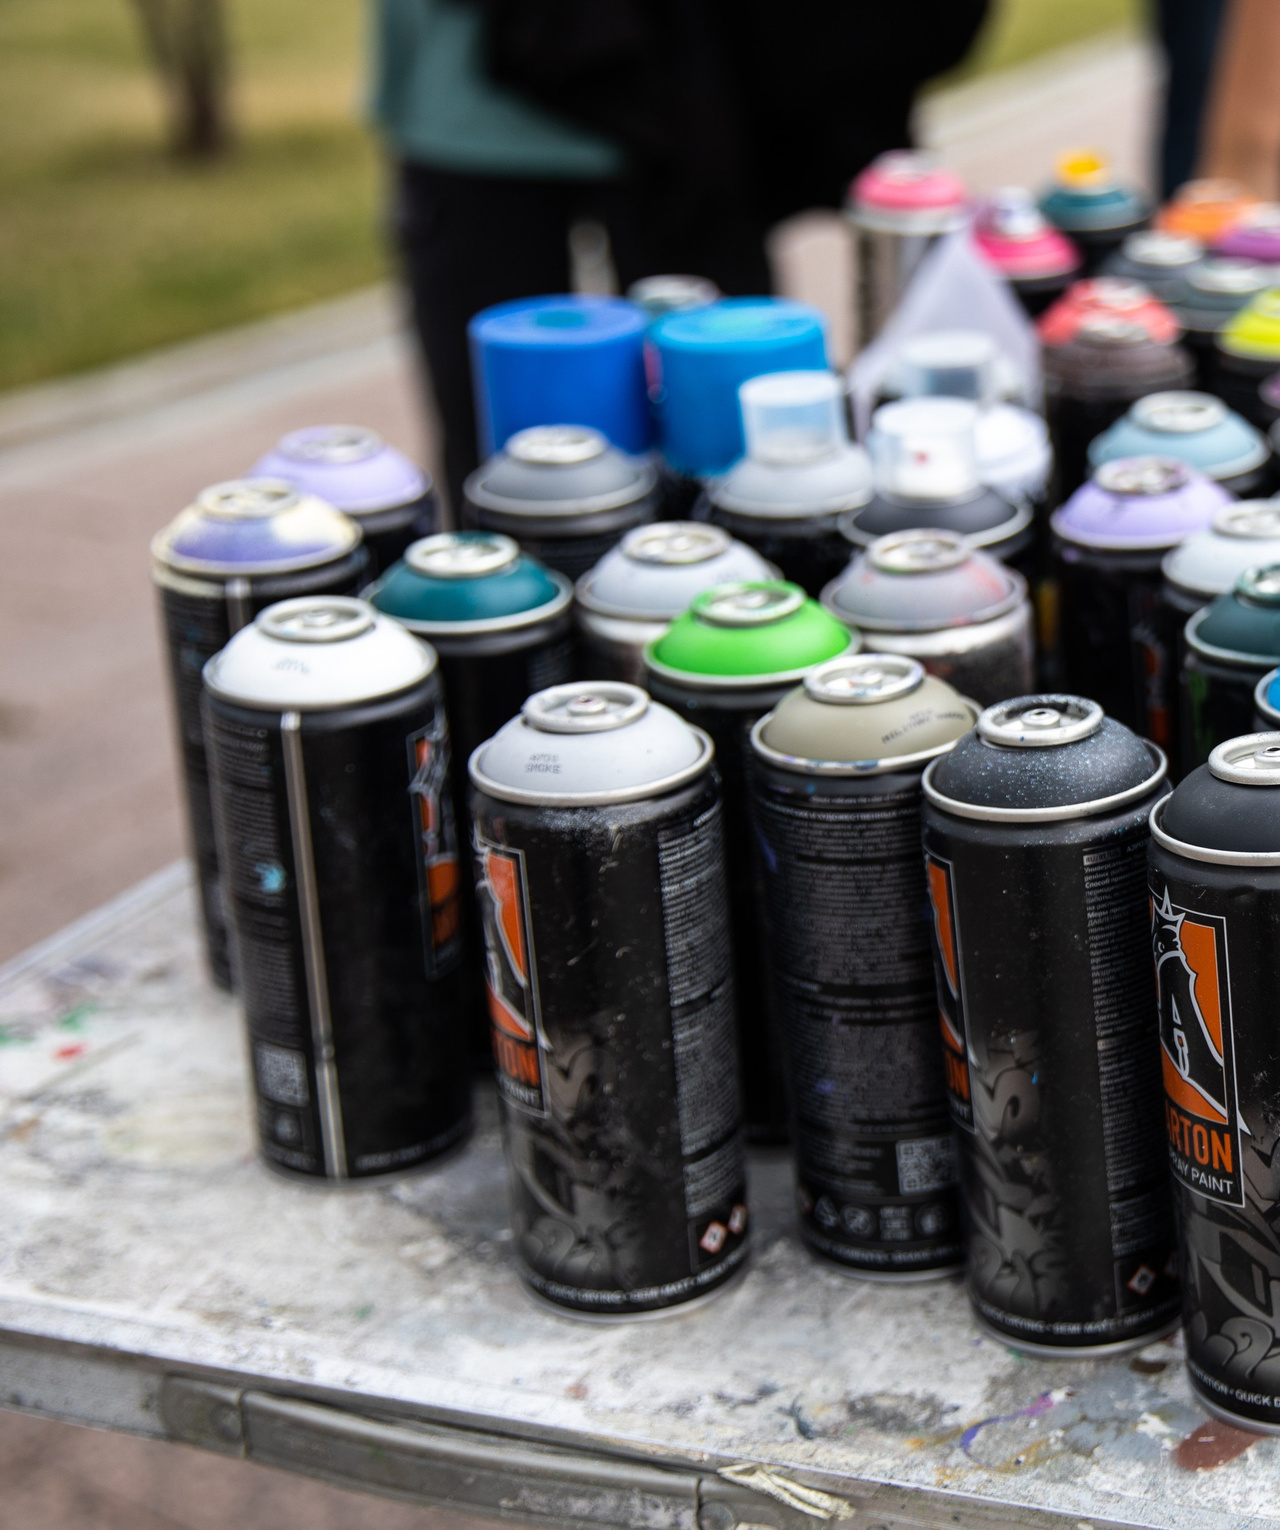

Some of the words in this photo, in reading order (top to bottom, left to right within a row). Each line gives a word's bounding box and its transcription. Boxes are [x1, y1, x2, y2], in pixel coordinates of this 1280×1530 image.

[524, 763, 560, 774] SMOKE
[1085, 878, 1110, 889] Способ
[1087, 910, 1108, 919] Меры
[1191, 1167, 1233, 1195] PAINT
[1052, 1321, 1081, 1335] SEMI
[1235, 1388, 1271, 1407] QUICK
